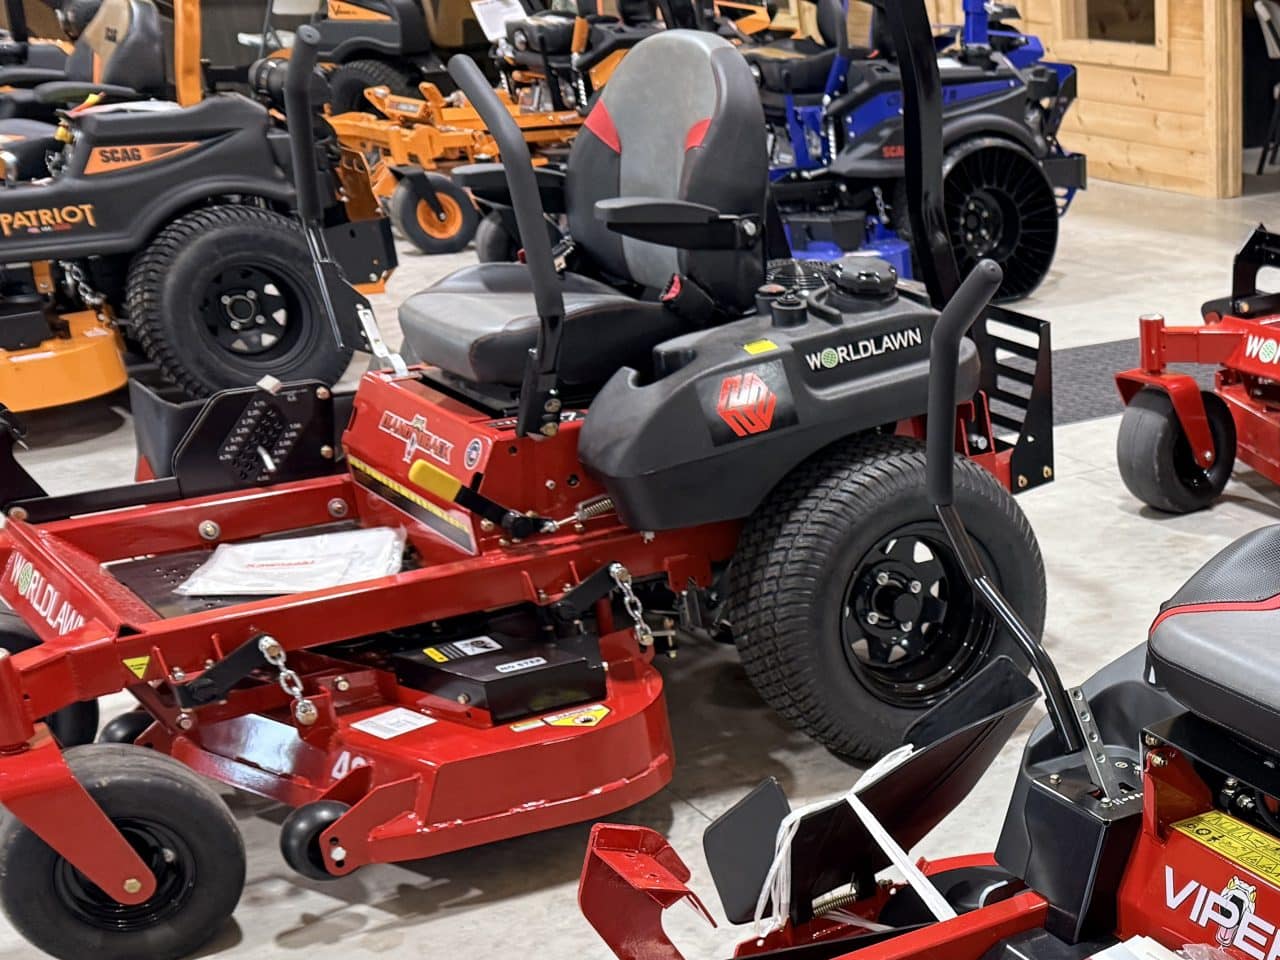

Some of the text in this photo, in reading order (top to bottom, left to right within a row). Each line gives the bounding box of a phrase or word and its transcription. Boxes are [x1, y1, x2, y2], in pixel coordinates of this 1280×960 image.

[99, 147, 142, 163] SCAG
[0, 203, 97, 237] PATRIOT
[805, 327, 922, 371] WORLDLAWN
